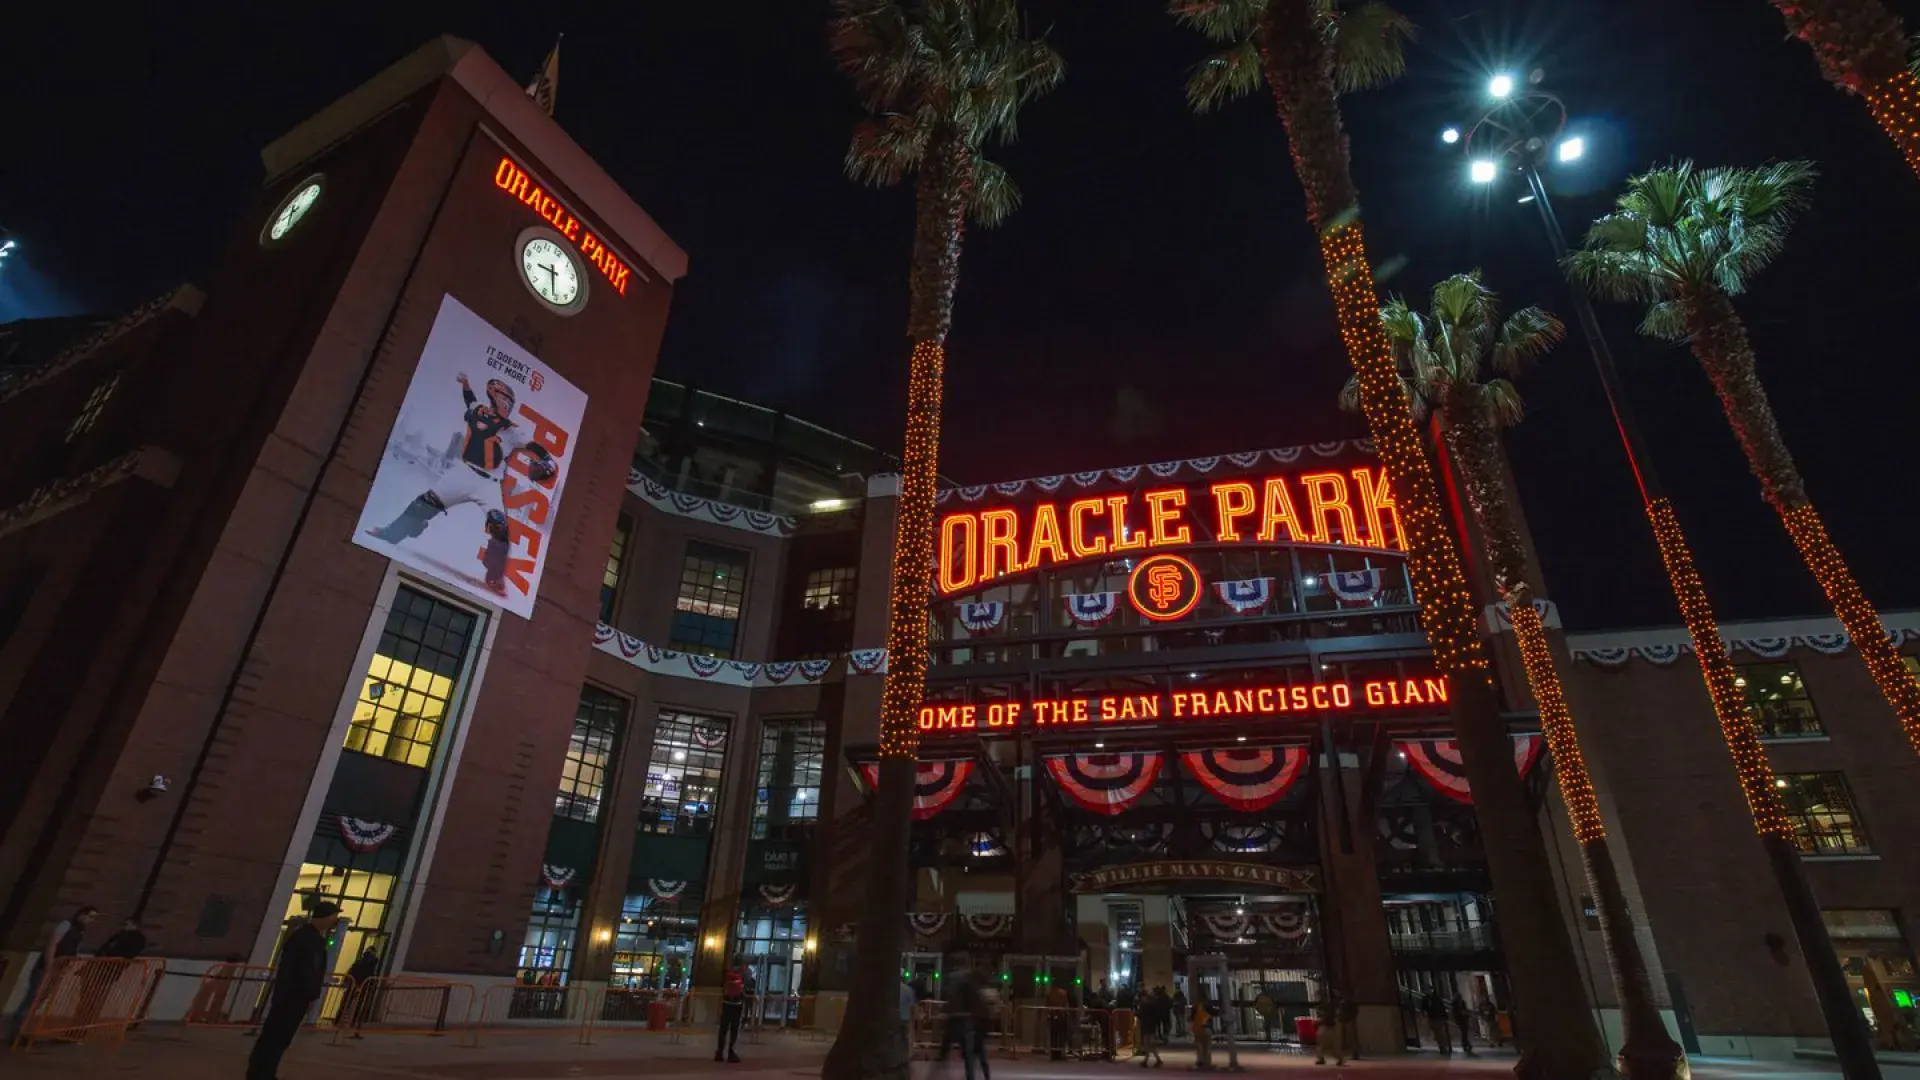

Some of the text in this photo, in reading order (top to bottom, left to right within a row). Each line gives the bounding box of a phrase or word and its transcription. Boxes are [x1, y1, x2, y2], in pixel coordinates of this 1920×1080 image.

[495, 158, 630, 295] ORACLE PARK
[486, 345, 531, 374] IT DOESN'T
[486, 357, 527, 385] GET MORE
[939, 467, 1409, 593] ORACLE PARK
[1148, 564, 1182, 608] SF
[920, 678, 1447, 729] OME OF THE SAN FRANCISCO GIAN
[1095, 863, 1287, 884] WILLIE MAYS GATE
